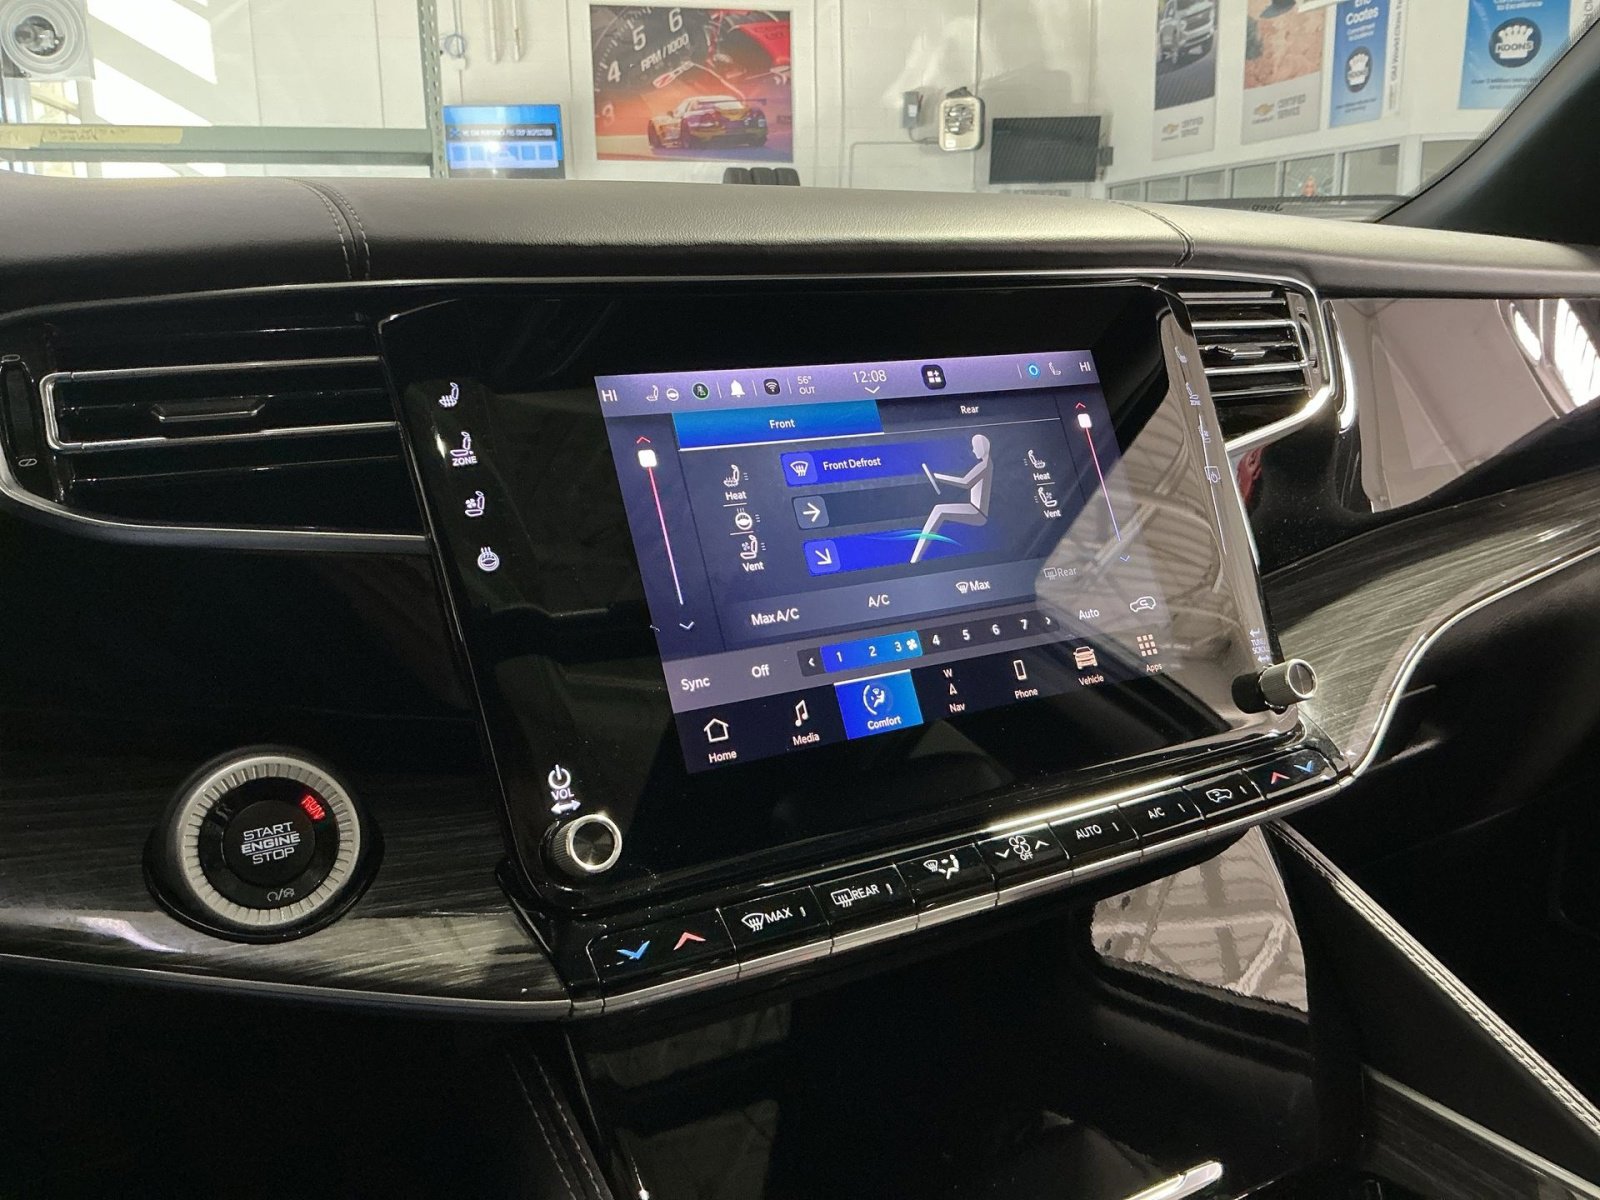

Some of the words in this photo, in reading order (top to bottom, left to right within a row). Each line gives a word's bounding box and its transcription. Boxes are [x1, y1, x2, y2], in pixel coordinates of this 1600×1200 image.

[668, 8, 683, 32] 6
[1345, 7, 1379, 25] Coates
[632, 25, 646, 50] 5
[1497, 42, 1534, 52] KOONS
[607, 61, 621, 83] 4
[602, 103, 615, 127] 3
[1079, 361, 1091, 373] HI
[853, 369, 887, 384] 12:08
[601, 389, 618, 402] HI
[799, 386, 816, 395] OUT
[960, 405, 979, 414] Rear
[769, 418, 796, 430] Front
[452, 455, 478, 467] ZONE
[823, 459, 848, 471] Front
[849, 457, 882, 469] Defrost
[1033, 472, 1051, 481] Heat
[725, 490, 747, 502] Heat
[1044, 509, 1062, 519] Vent
[742, 561, 765, 573] Vent
[1057, 566, 1077, 578] Rear
[969, 580, 991, 591] Max
[868, 594, 890, 608] A/C
[751, 612, 775, 626] Max
[776, 608, 800, 621] A/C
[1079, 608, 1100, 621] Auto
[836, 652, 843, 663] 1
[868, 646, 877, 657] 2
[894, 641, 903, 652] 3
[932, 634, 941, 646] 4
[962, 629, 971, 641] 5
[992, 624, 1001, 636] 6
[1020, 618, 1029, 630] 7
[751, 664, 770, 678] Off
[943, 668, 953, 679] W
[1146, 663, 1163, 673] Apps
[681, 677, 711, 692] Sync
[1078, 674, 1104, 686] Vehicle
[1014, 687, 1039, 699] Phone
[950, 702, 966, 713] Nav
[867, 716, 902, 730] Comfort
[793, 734, 820, 746] Media
[709, 750, 737, 763] Home
[551, 787, 575, 800] VOL
[302, 795, 326, 821] RUN
[1148, 806, 1166, 819] A/C
[243, 821, 294, 841] START
[1075, 824, 1102, 840] AUTO
[241, 833, 301, 854] ENGINE
[252, 847, 295, 865] STOP
[1020, 851, 1034, 861] OFF
[852, 884, 880, 900] REAR
[764, 907, 793, 924] MAX
